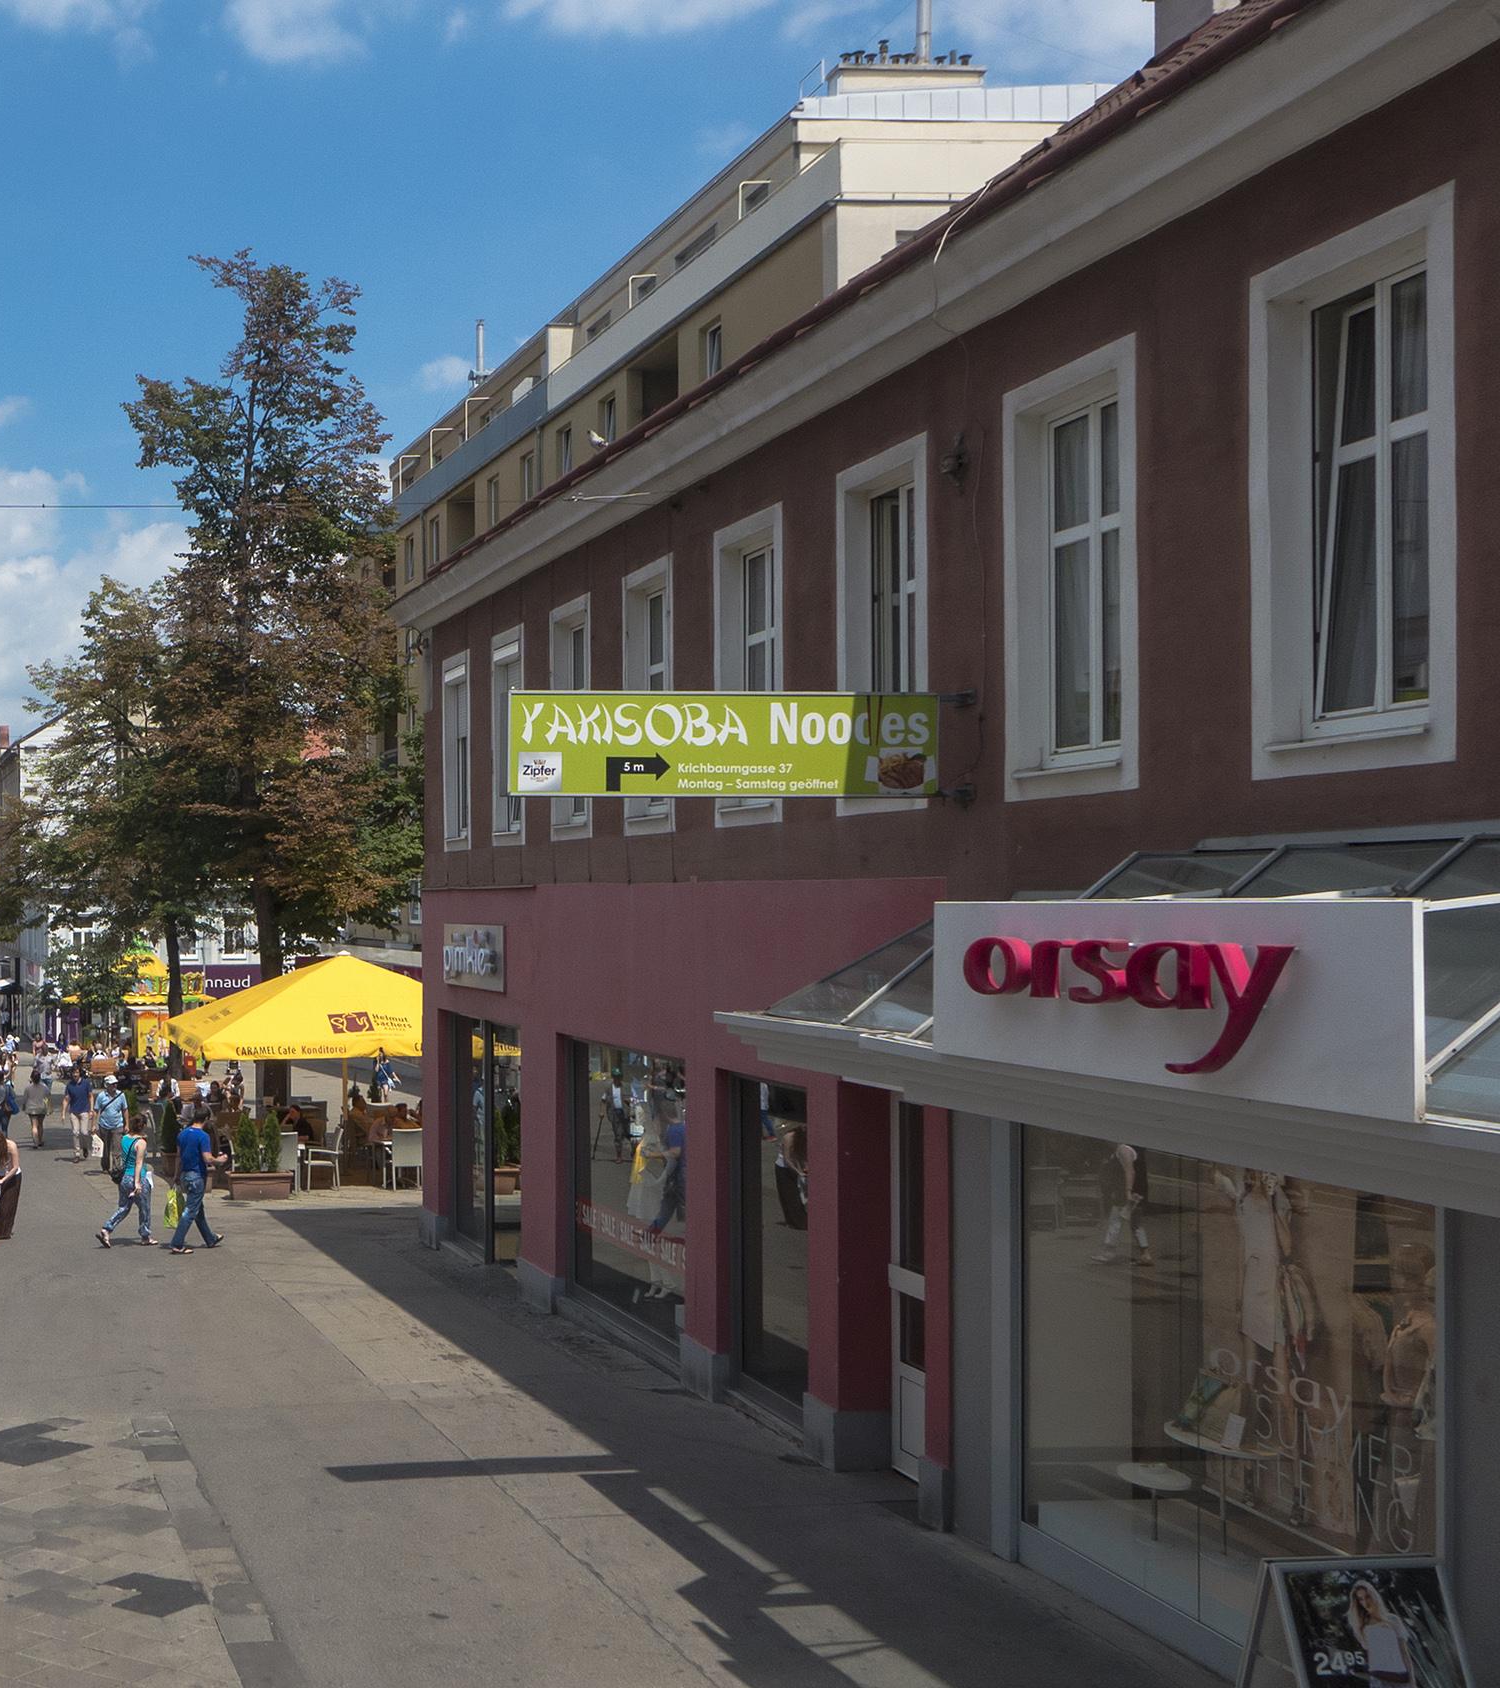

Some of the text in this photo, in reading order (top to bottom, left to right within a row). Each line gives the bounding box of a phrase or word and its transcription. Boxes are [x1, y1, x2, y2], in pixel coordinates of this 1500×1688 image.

[521, 702, 748, 746] YAKISOBA
[522, 764, 557, 777] Zipfer
[623, 762, 644, 772] 5 m
[677, 763, 793, 776] Krichbaumgasse 37
[677, 779, 723, 791] Montag
[736, 779, 786, 791] Samstag
[789, 779, 839, 791] geöffnet
[963, 936, 1296, 1074] orsay
[235, 1045, 276, 1056] CARAMEL
[301, 1044, 347, 1055] Konditorei
